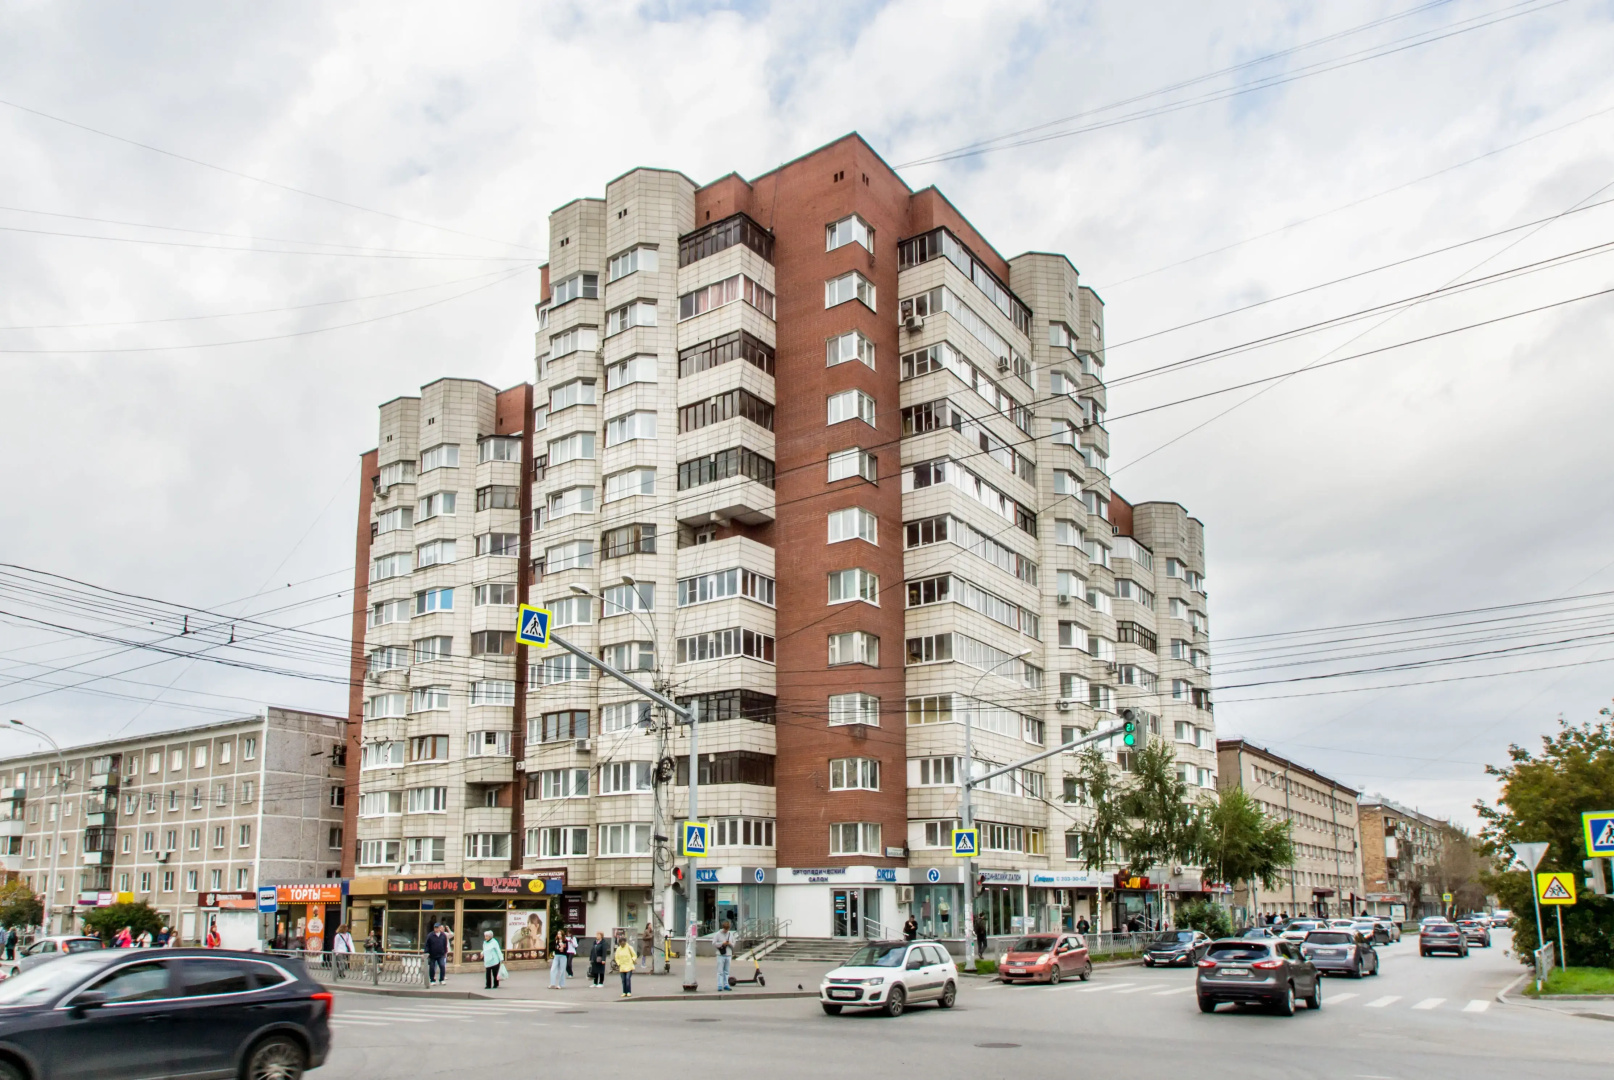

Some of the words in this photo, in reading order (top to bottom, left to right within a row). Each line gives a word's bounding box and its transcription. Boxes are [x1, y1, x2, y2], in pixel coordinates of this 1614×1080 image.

[876, 869, 896, 881] ORTIX
[427, 880, 441, 890] Hot
[442, 879, 459, 891] Dog
[483, 877, 521, 887] ШАУРМА
[290, 889, 321, 900] ТОРТЫ
